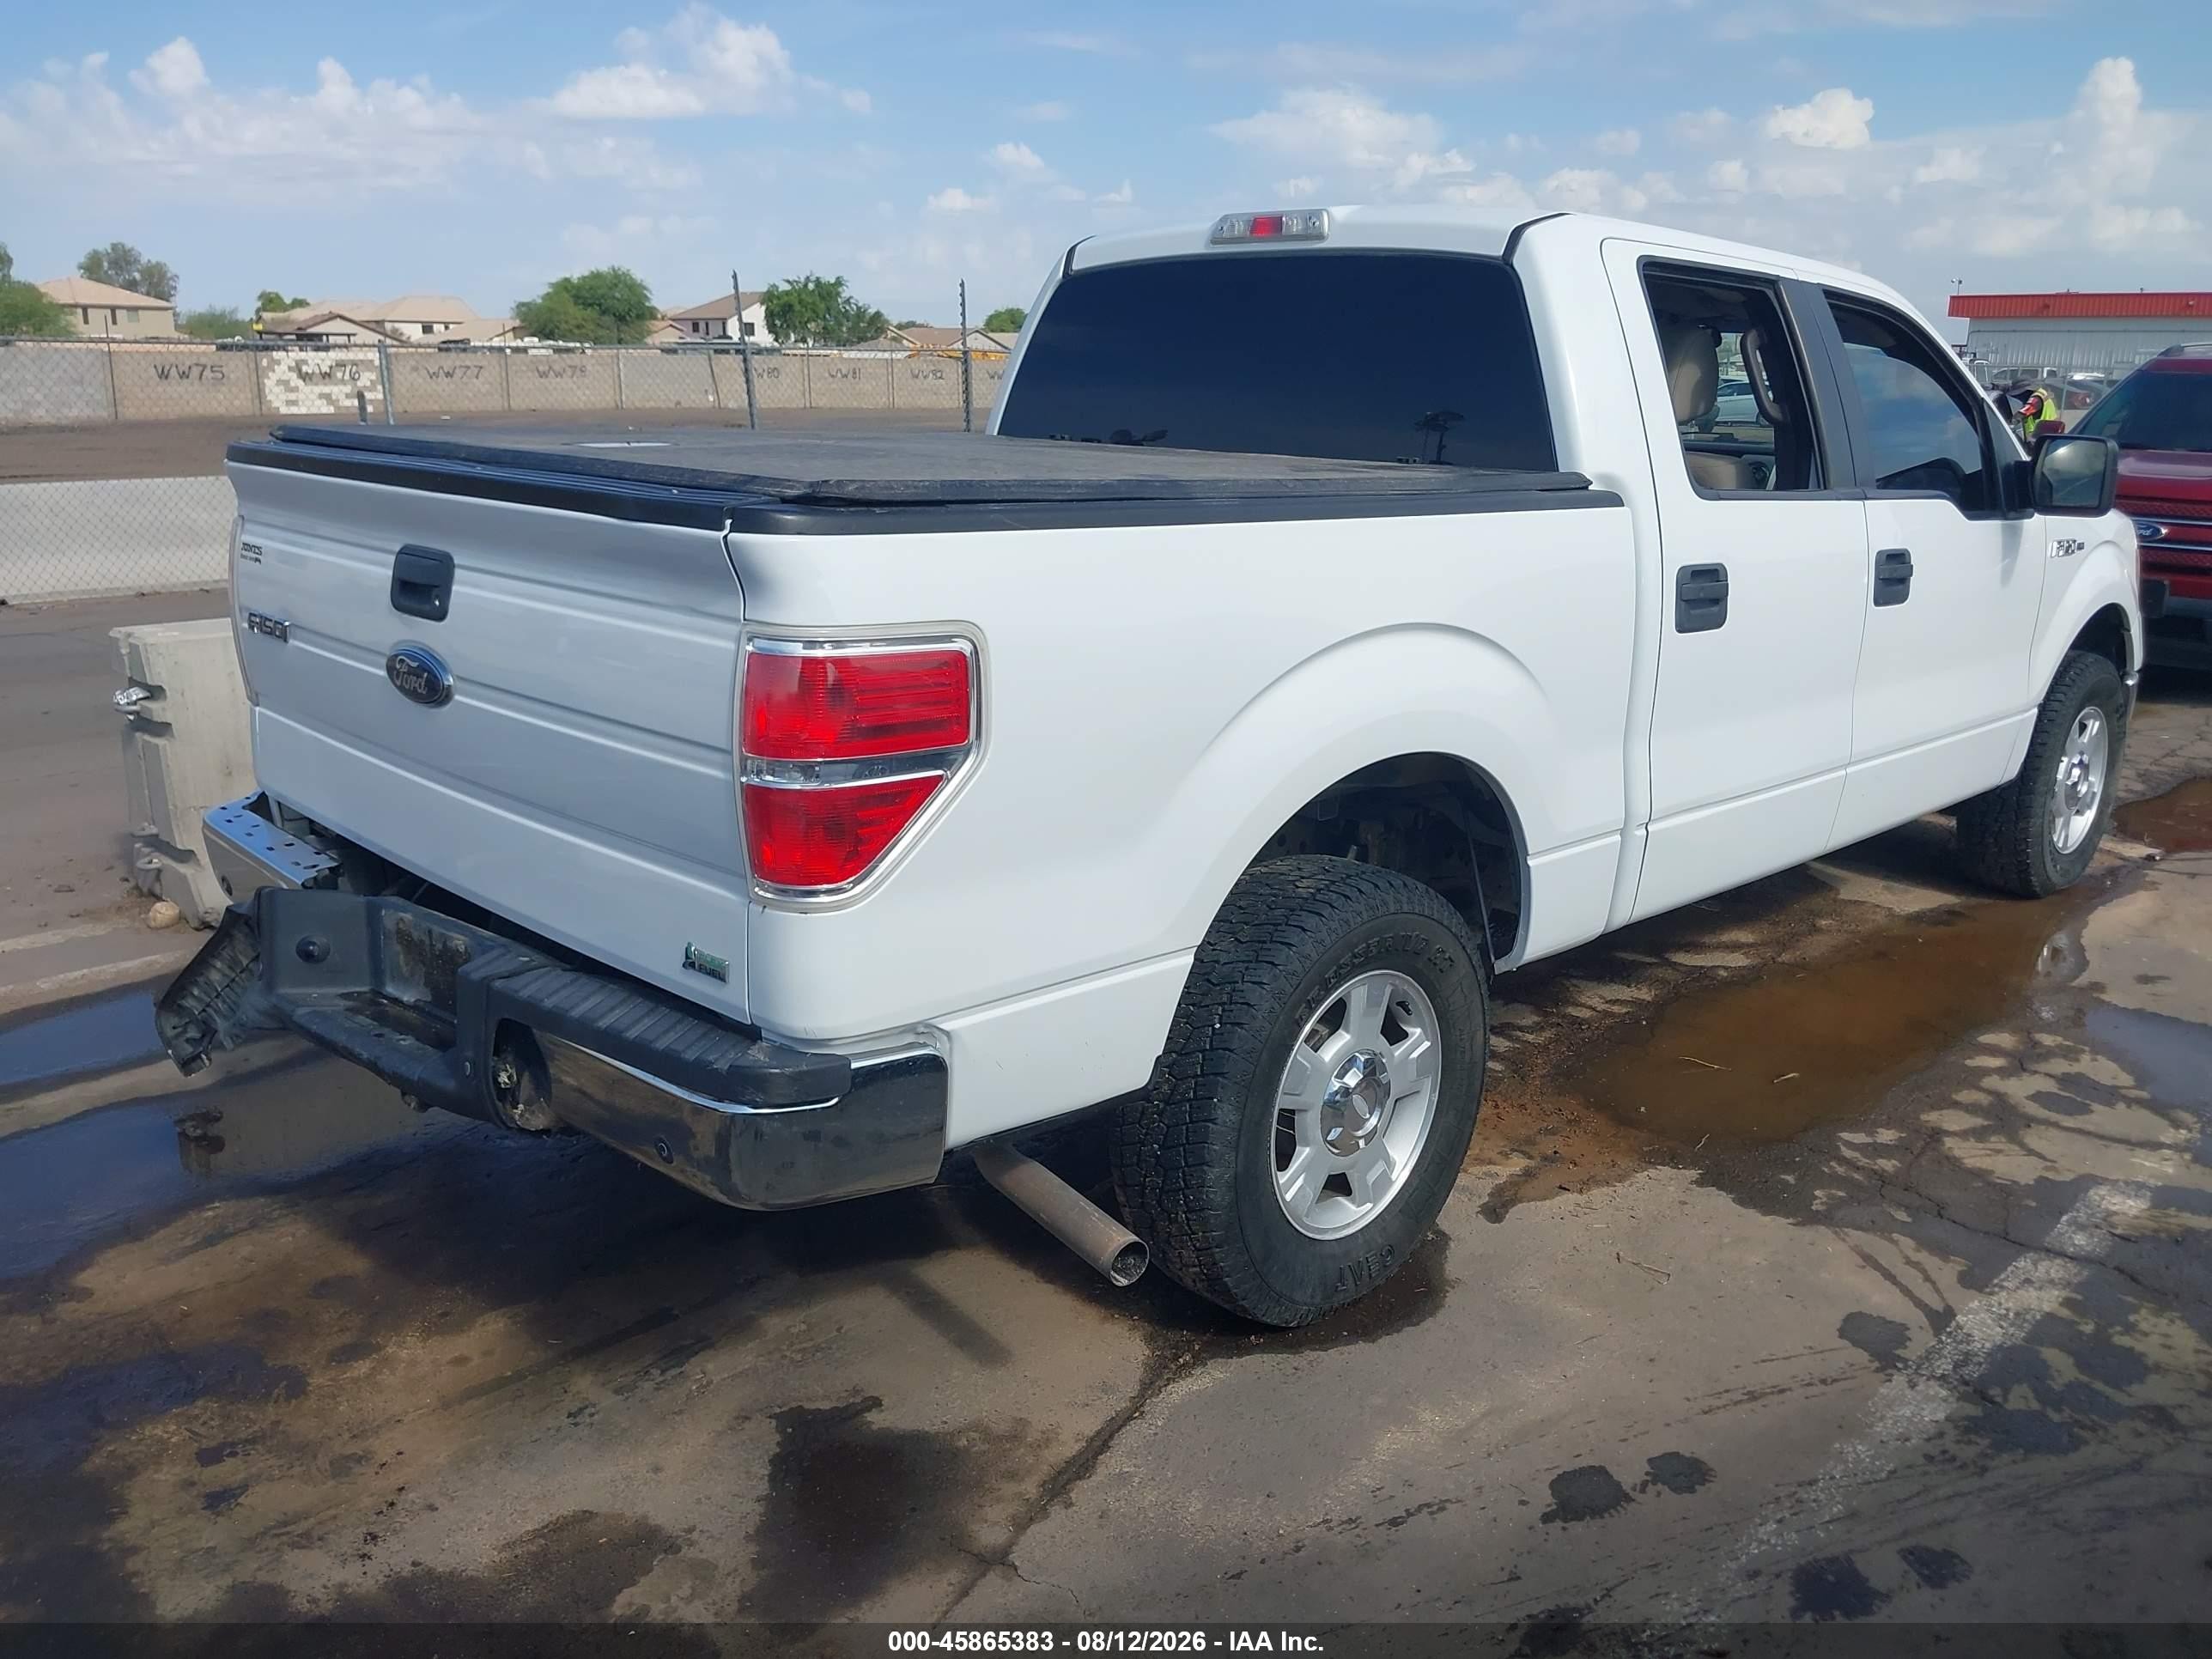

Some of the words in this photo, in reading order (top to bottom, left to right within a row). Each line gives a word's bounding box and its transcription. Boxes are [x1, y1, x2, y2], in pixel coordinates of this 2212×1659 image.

[154, 363, 225, 381] WW75
[296, 362, 361, 384] WW76
[425, 365, 483, 380] WW77
[747, 367, 780, 379] W80
[828, 368, 860, 380] WW81
[911, 369, 944, 380] WW82
[394, 656, 428, 695] Ford
